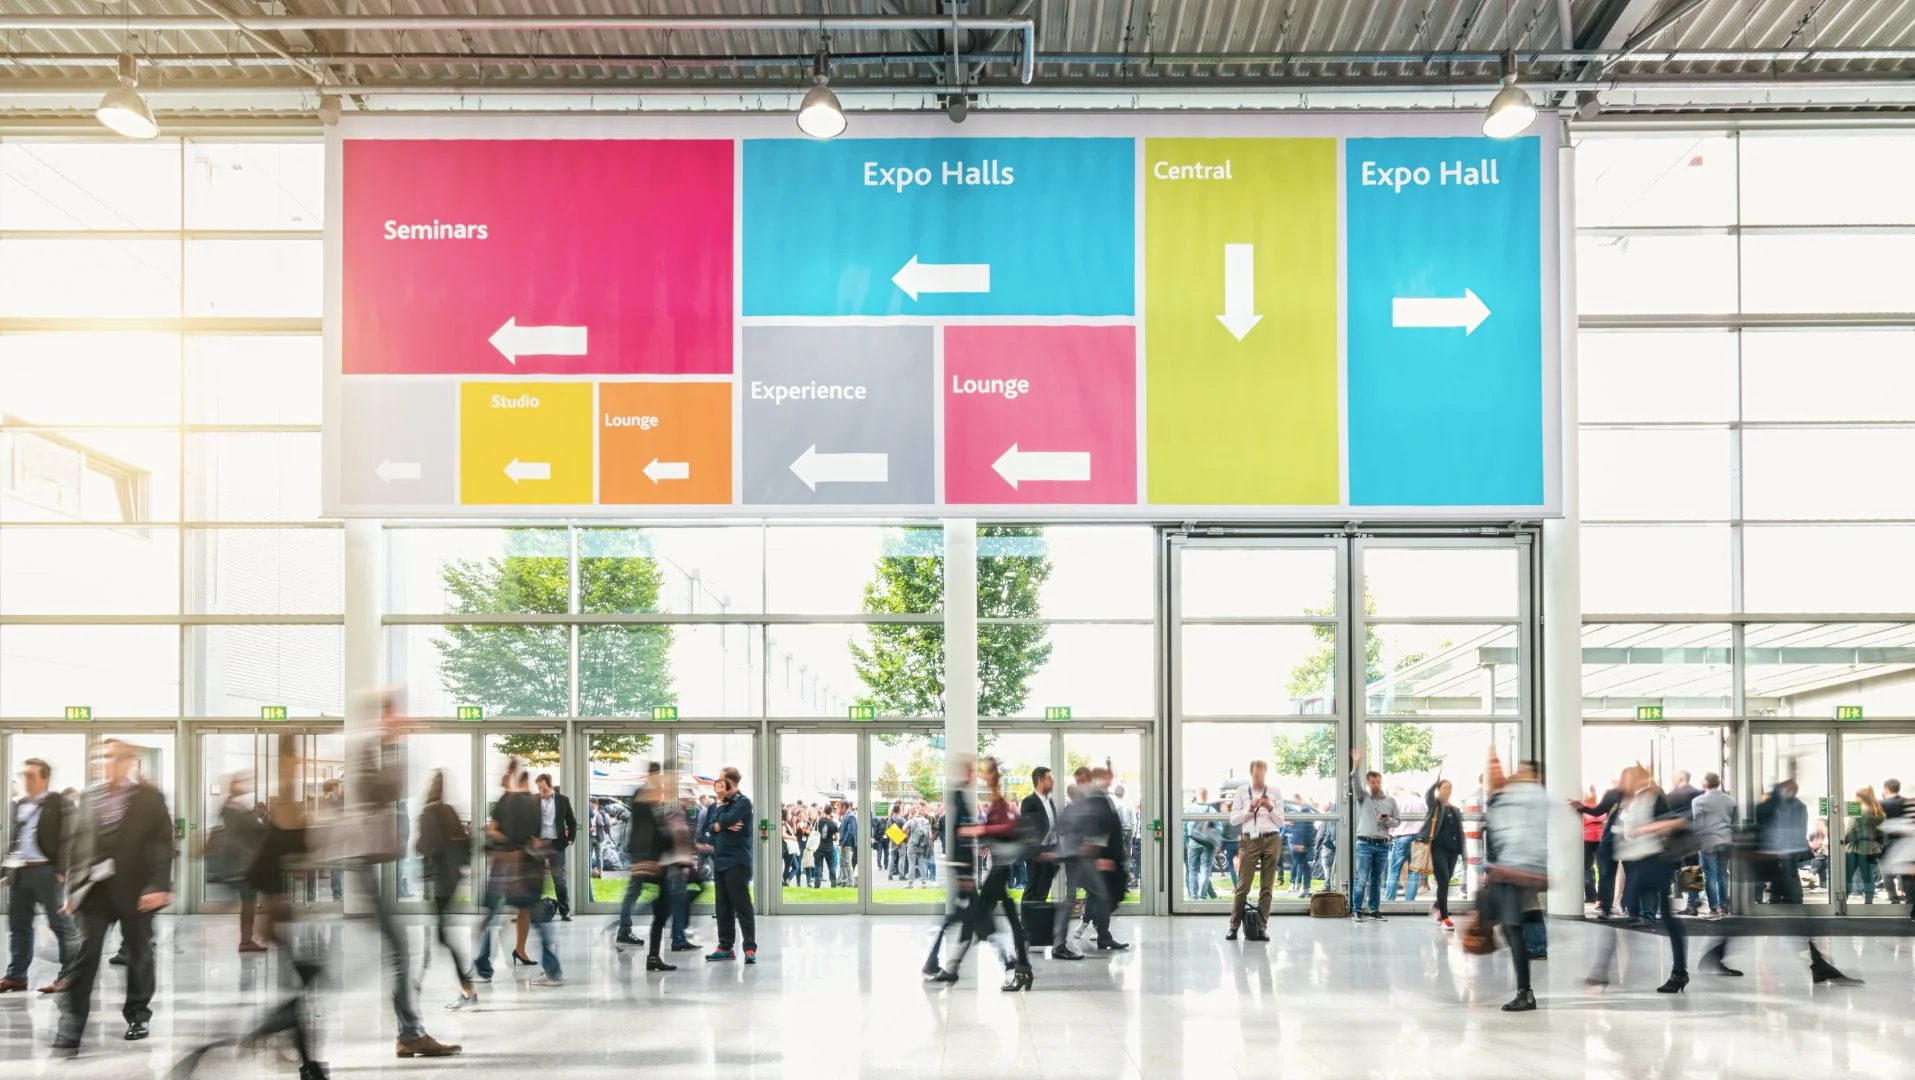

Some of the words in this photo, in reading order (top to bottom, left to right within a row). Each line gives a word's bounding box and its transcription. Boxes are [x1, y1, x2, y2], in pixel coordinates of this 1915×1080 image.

[863, 161, 932, 194] Expo
[943, 159, 1015, 186] Halls
[1153, 159, 1233, 180] Central
[1361, 161, 1431, 194] Expo
[1440, 158, 1500, 186] Hall
[383, 219, 489, 240] Seminars
[750, 379, 867, 405] Experience
[952, 374, 1030, 400] Lounge
[490, 394, 540, 409] Studio
[604, 413, 659, 431] Lounge
